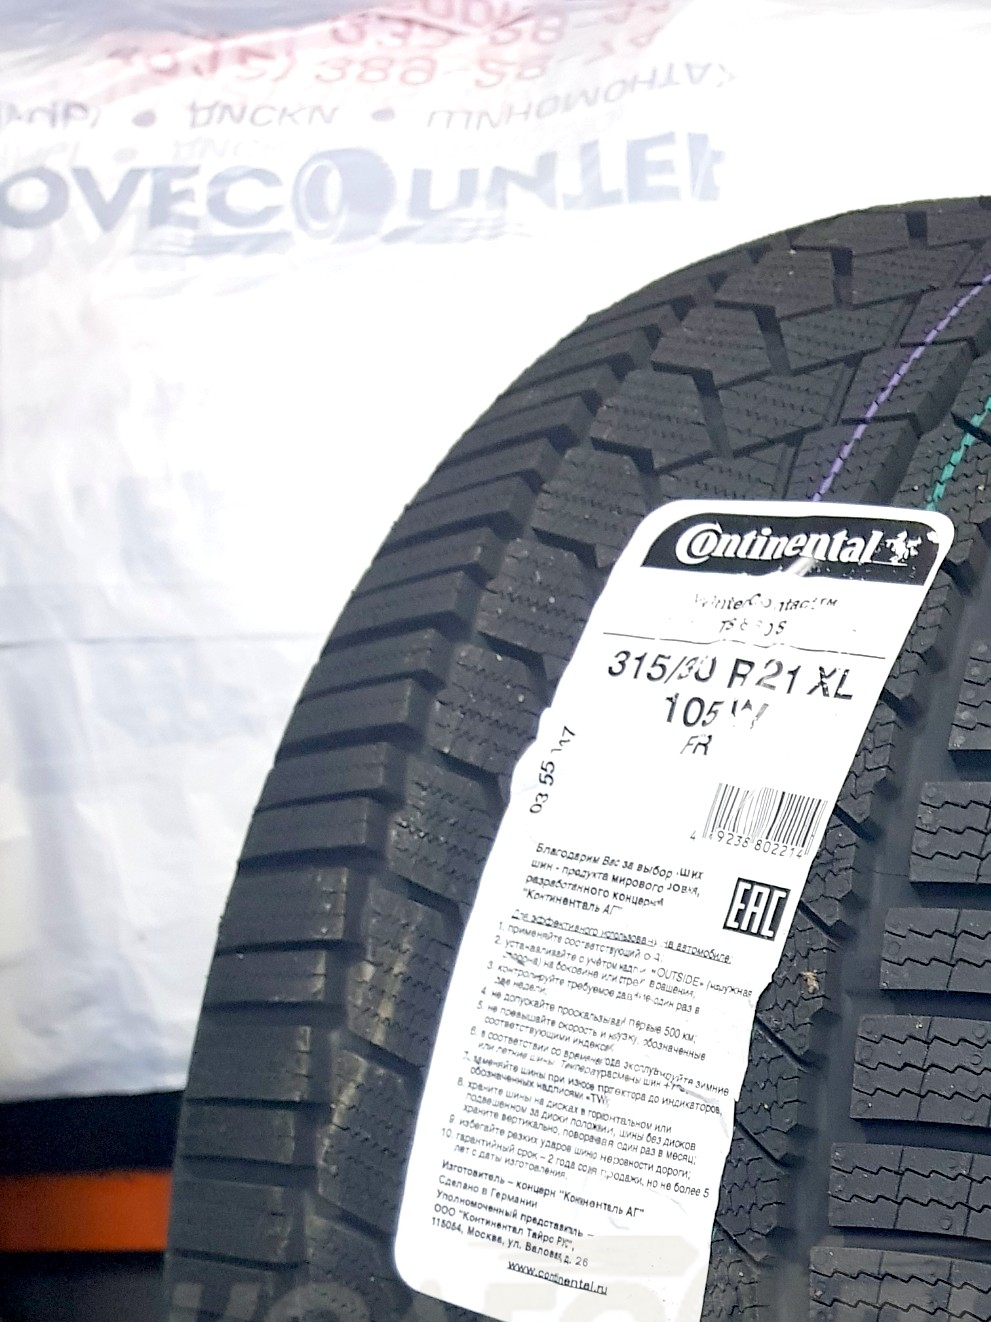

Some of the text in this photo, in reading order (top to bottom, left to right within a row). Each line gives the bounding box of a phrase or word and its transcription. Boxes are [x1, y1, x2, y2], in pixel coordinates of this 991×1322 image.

[675, 520, 885, 565] Continental
[607, 649, 718, 684] 315/30
[806, 665, 854, 700] XL
[680, 733, 713, 756] FR
[538, 760, 556, 787] 55
[636, 863, 673, 881] выбор
[610, 873, 665, 894] мирового
[675, 1002, 693, 1013] раз
[557, 1021, 598, 1037] скорость
[663, 1025, 681, 1039] 500
[550, 1046, 562, 1057] со
[694, 1080, 730, 1097] зимние
[547, 1073, 566, 1084] при
[647, 1094, 660, 1104] до
[642, 1078, 662, 1087] шин
[654, 1123, 672, 1134] или
[639, 1145, 656, 1157] раз
[645, 1132, 662, 1145] без
[662, 1137, 697, 1151] дисков
[516, 1147, 538, 1160] срок
[646, 1178, 659, 1189] но
[660, 1182, 672, 1191] не
[673, 1181, 701, 1197] более
[438, 1174, 480, 1193] Сделано
[490, 1187, 538, 1209] Германии
[515, 1180, 557, 1199] концерн
[433, 1202, 456, 1217] ООО
[436, 1188, 518, 1220] Уполномоченный
[466, 1225, 505, 1247] Москва,
[574, 1255, 589, 1268] 26
